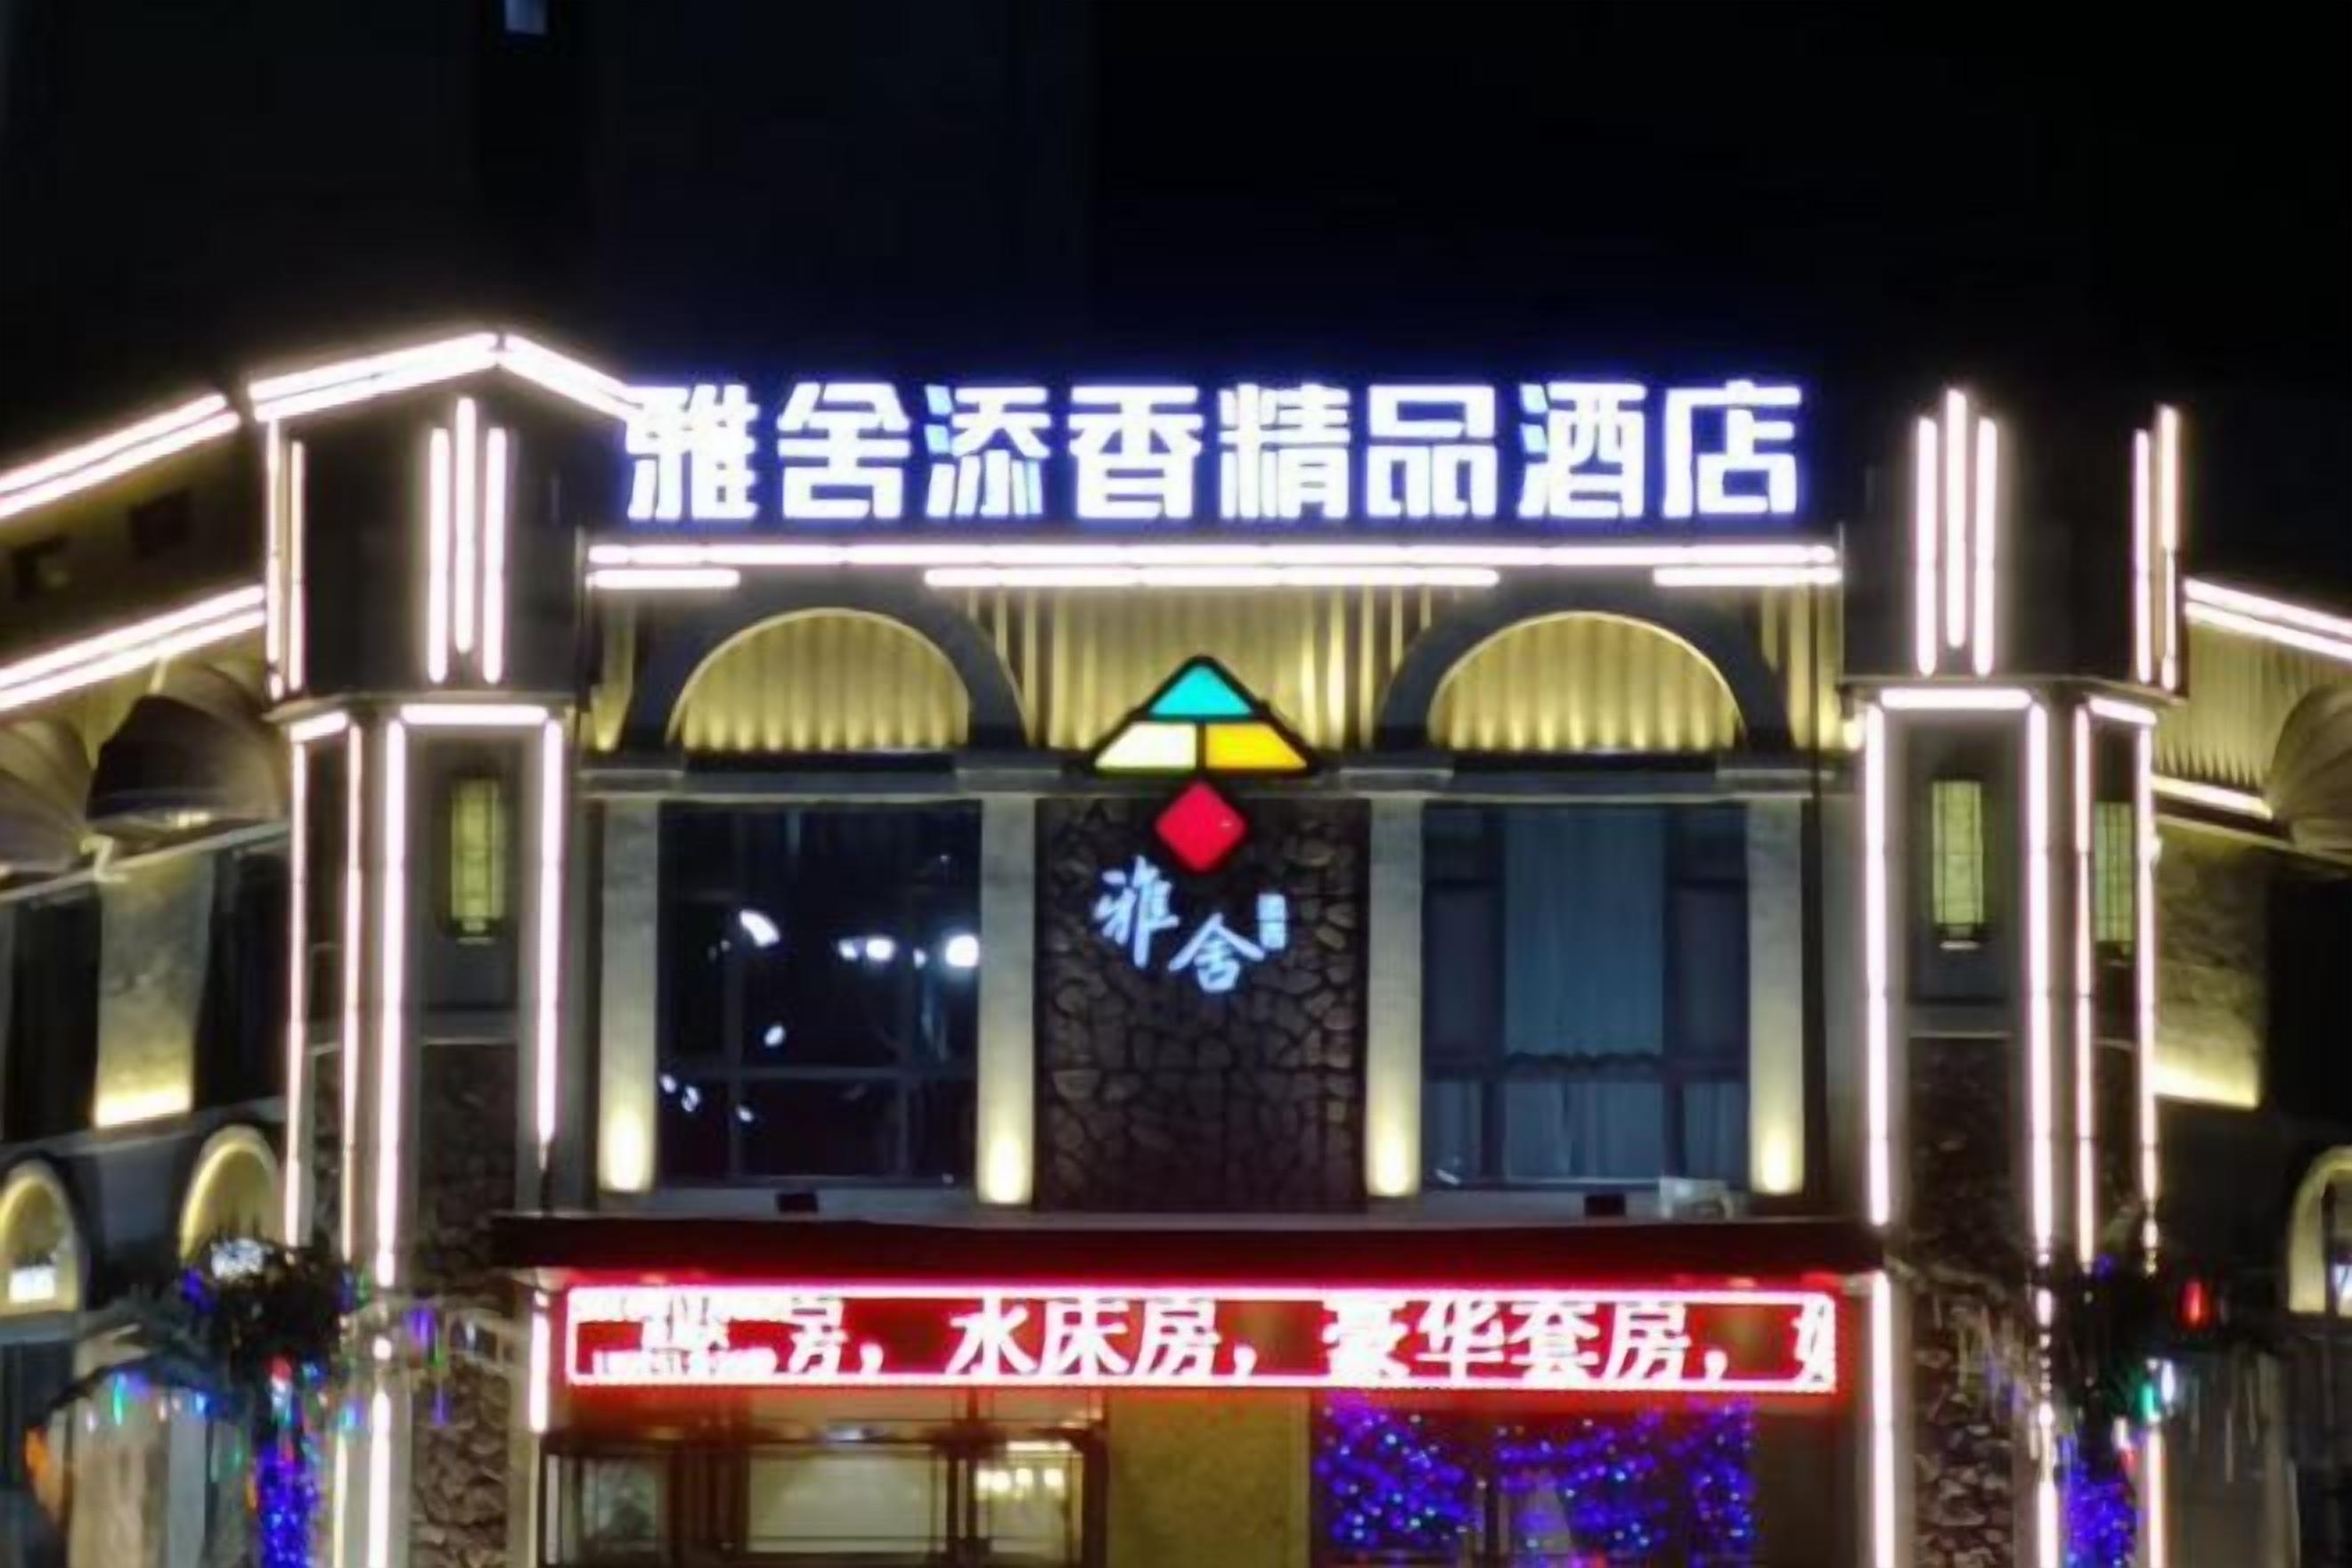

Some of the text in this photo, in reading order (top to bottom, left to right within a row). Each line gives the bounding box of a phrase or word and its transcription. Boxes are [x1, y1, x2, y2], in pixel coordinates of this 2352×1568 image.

[625, 380, 1801, 519] 雅舍添香精品酒店
